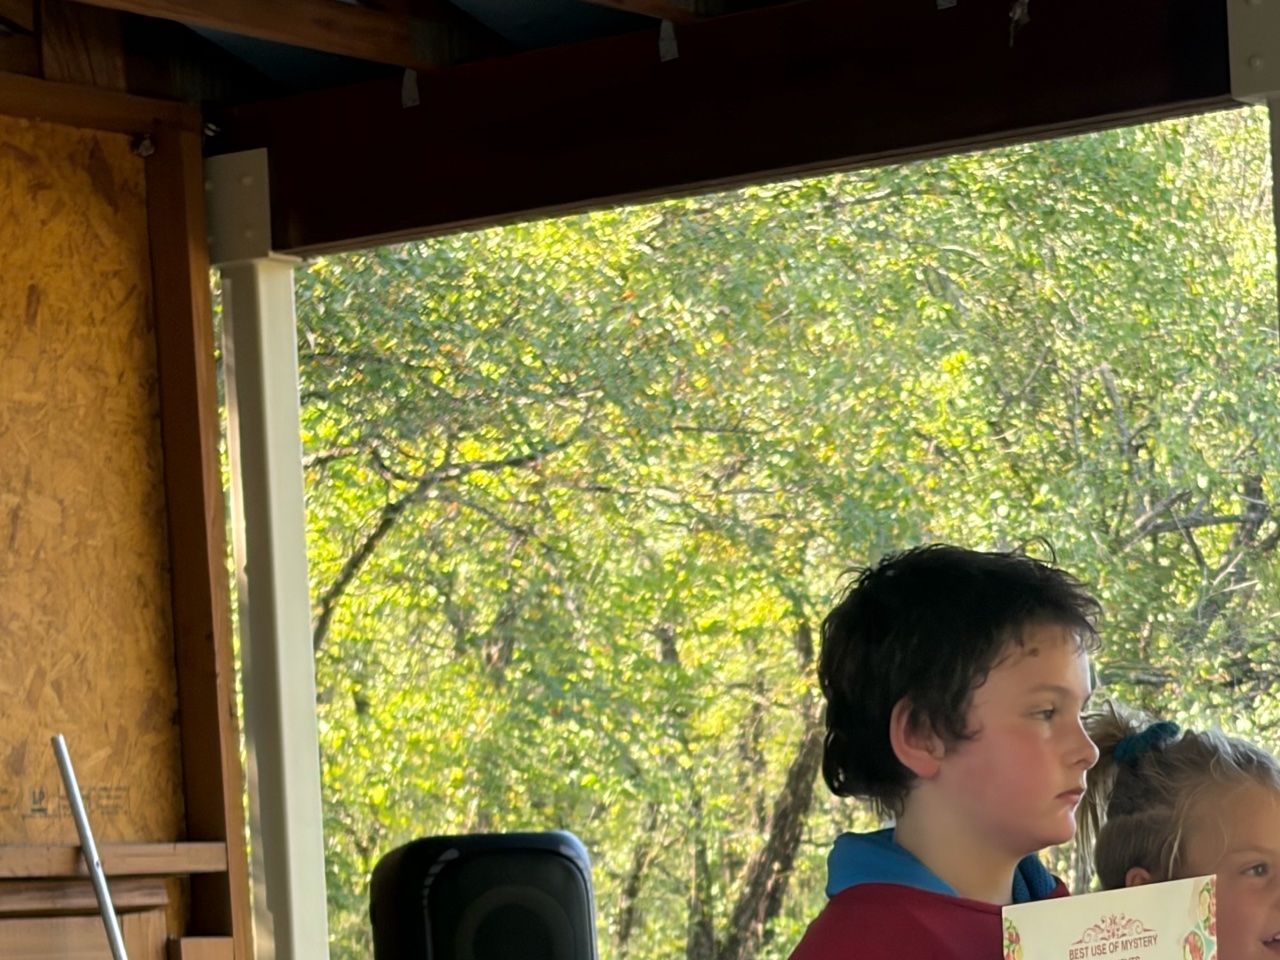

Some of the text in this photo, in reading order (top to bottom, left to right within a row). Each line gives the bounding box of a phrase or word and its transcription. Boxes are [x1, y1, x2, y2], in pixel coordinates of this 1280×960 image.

[1069, 934, 1158, 960] BEST USE OF MYSTERY
